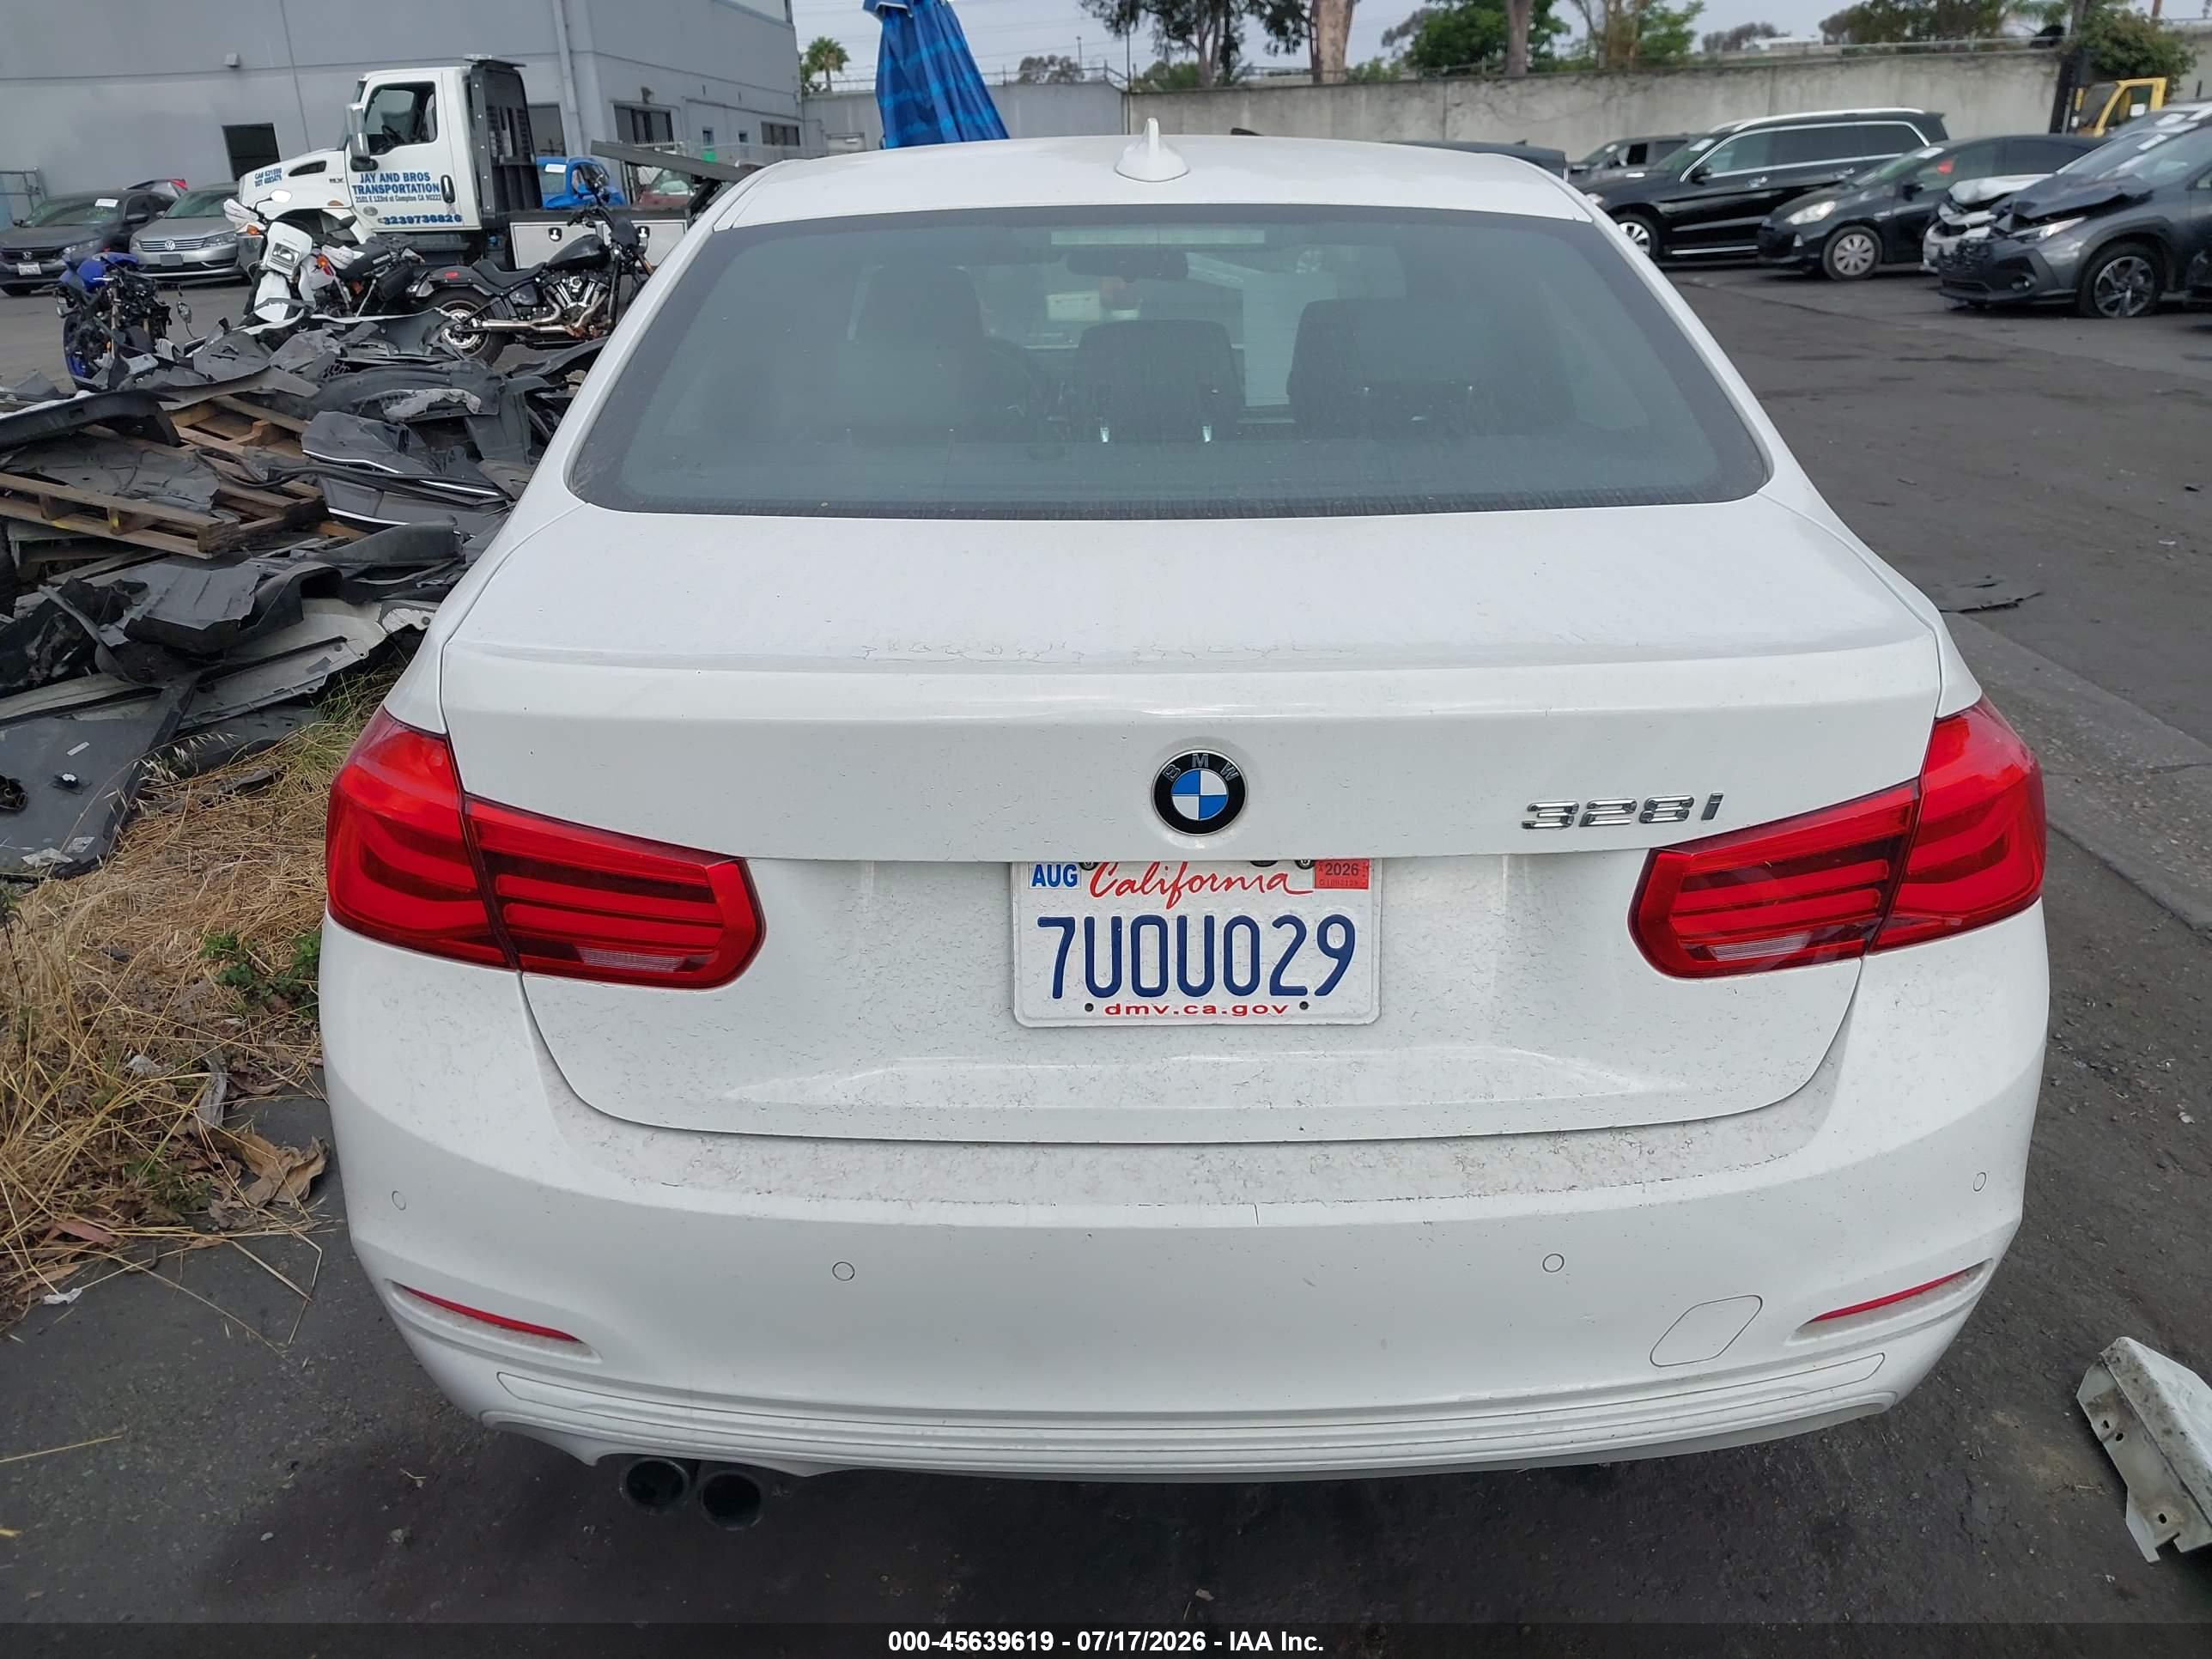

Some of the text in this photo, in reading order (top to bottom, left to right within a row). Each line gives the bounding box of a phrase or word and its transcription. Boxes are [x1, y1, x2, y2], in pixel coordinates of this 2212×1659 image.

[361, 172, 430, 183] JAY AND BROS
[352, 183, 440, 195] TRANSPORTATION
[395, 194, 416, 204] Compton
[1162, 753, 1240, 782] BMW
[1522, 792, 1724, 830] 328i
[1031, 863, 1078, 888] AUG
[1325, 862, 1359, 876] 2026
[1089, 860, 1314, 909] California
[1103, 1003, 1290, 1018] dmv.ca.gov
